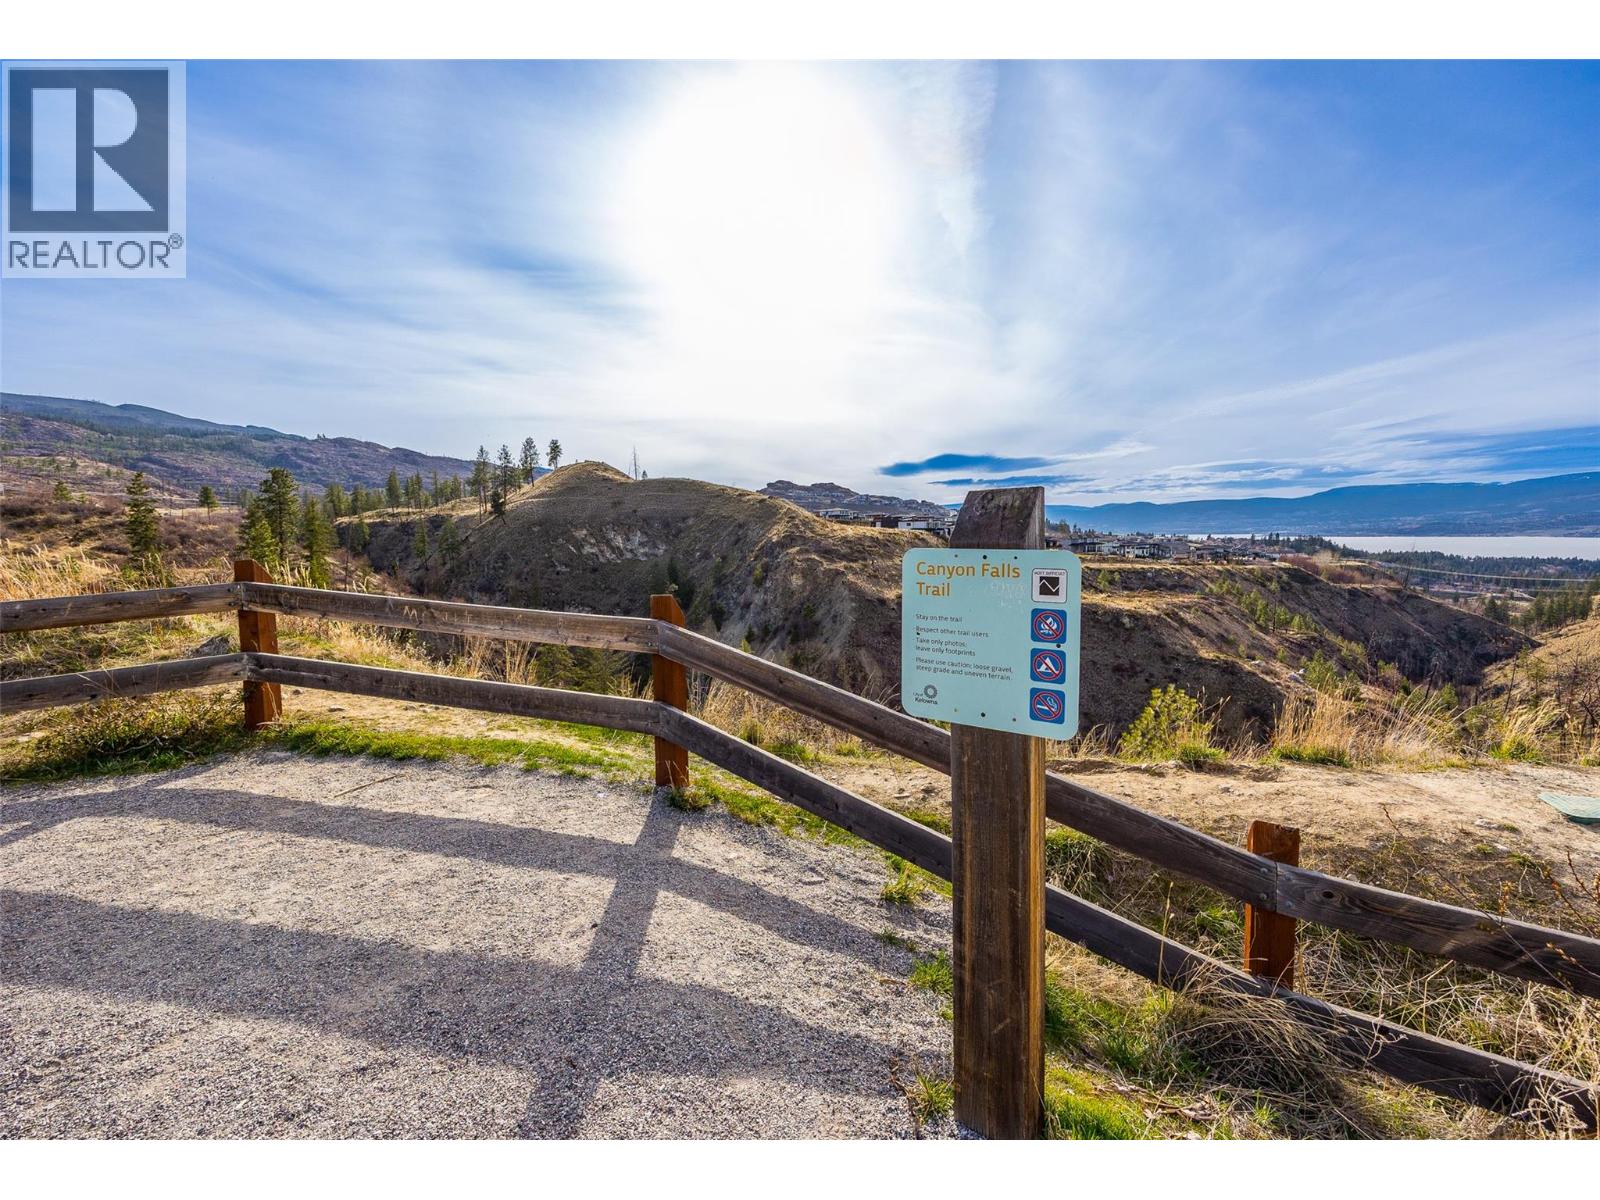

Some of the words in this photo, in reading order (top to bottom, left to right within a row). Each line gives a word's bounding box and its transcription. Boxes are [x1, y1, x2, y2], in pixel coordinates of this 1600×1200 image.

[916, 562, 976, 579] Canyon
[981, 563, 1020, 578] Falls
[916, 582, 951, 597] Trail
[931, 639, 944, 647] only
[932, 646, 945, 654] only
[945, 648, 976, 657] footprints
[964, 670, 988, 678] uneven
[914, 697, 939, 705] Kelowna
